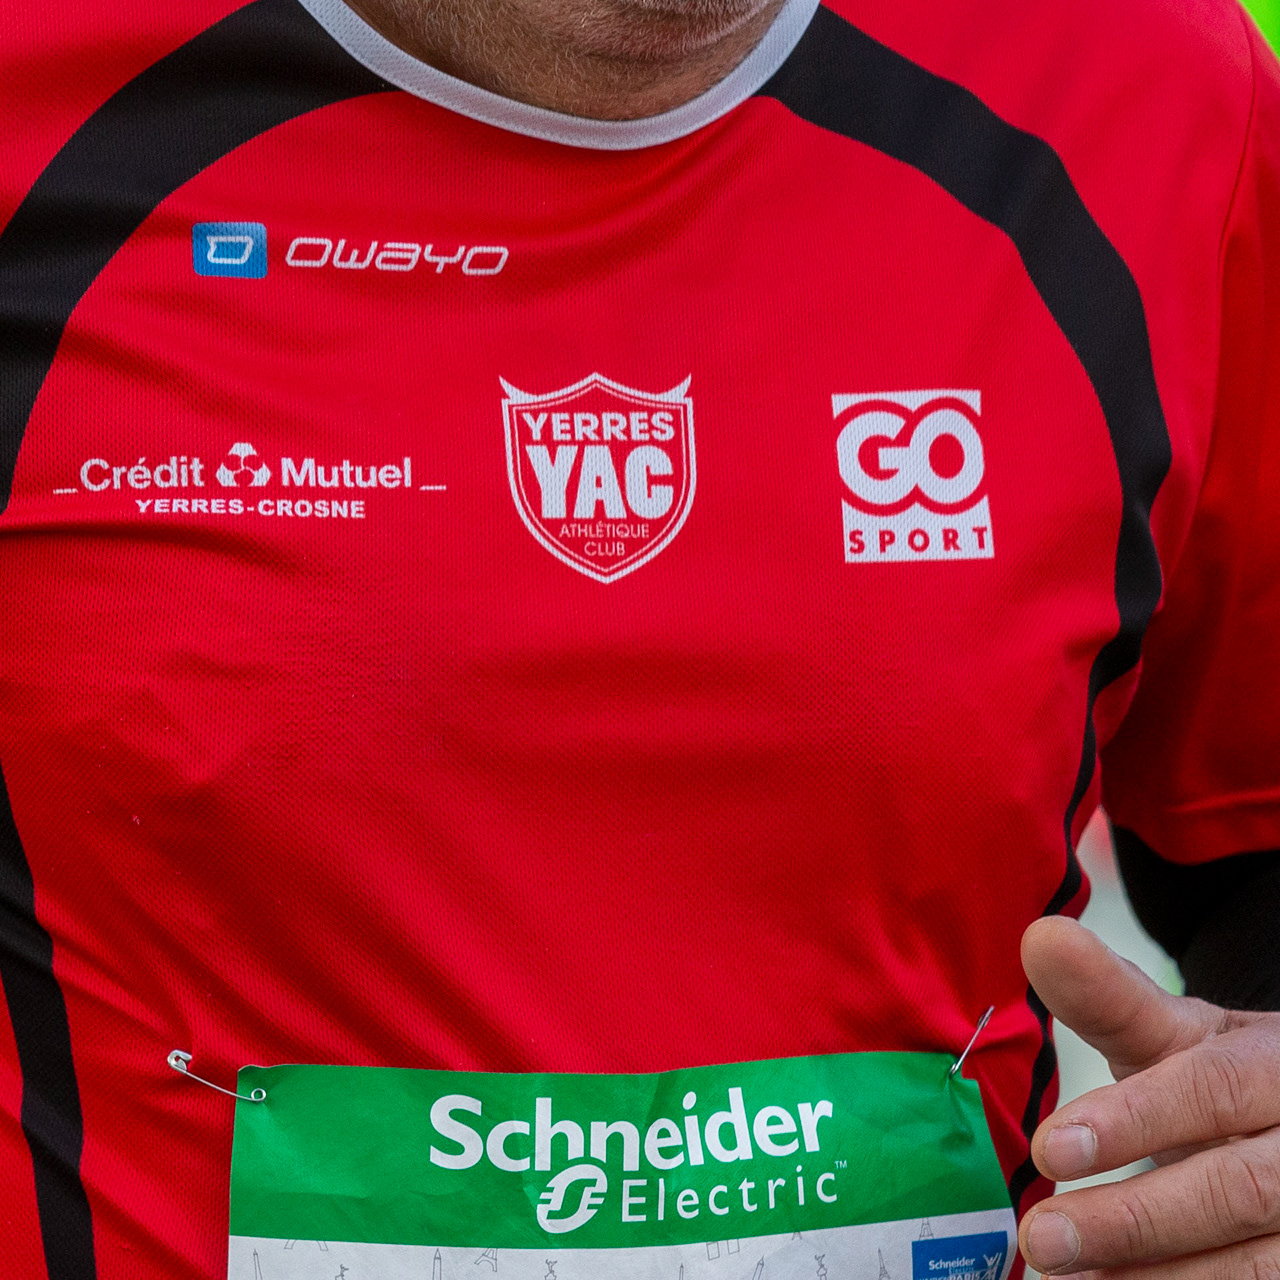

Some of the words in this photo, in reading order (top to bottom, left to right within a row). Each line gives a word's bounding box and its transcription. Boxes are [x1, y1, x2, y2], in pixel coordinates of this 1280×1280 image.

[522, 411, 675, 441] YERRES
[836, 408, 985, 505] GO
[80, 455, 204, 492] Crédit
[281, 456, 412, 489] Mutuel
[525, 445, 674, 519] YAC
[134, 498, 366, 519] YERRES-CROSNE
[559, 521, 650, 538] ATHLÉTIQUE
[848, 526, 988, 554] SPORT
[584, 541, 626, 556] CLUB
[429, 1086, 834, 1172] Schneider
[622, 1164, 838, 1223] Electric
[928, 1256, 976, 1271] Schneider
